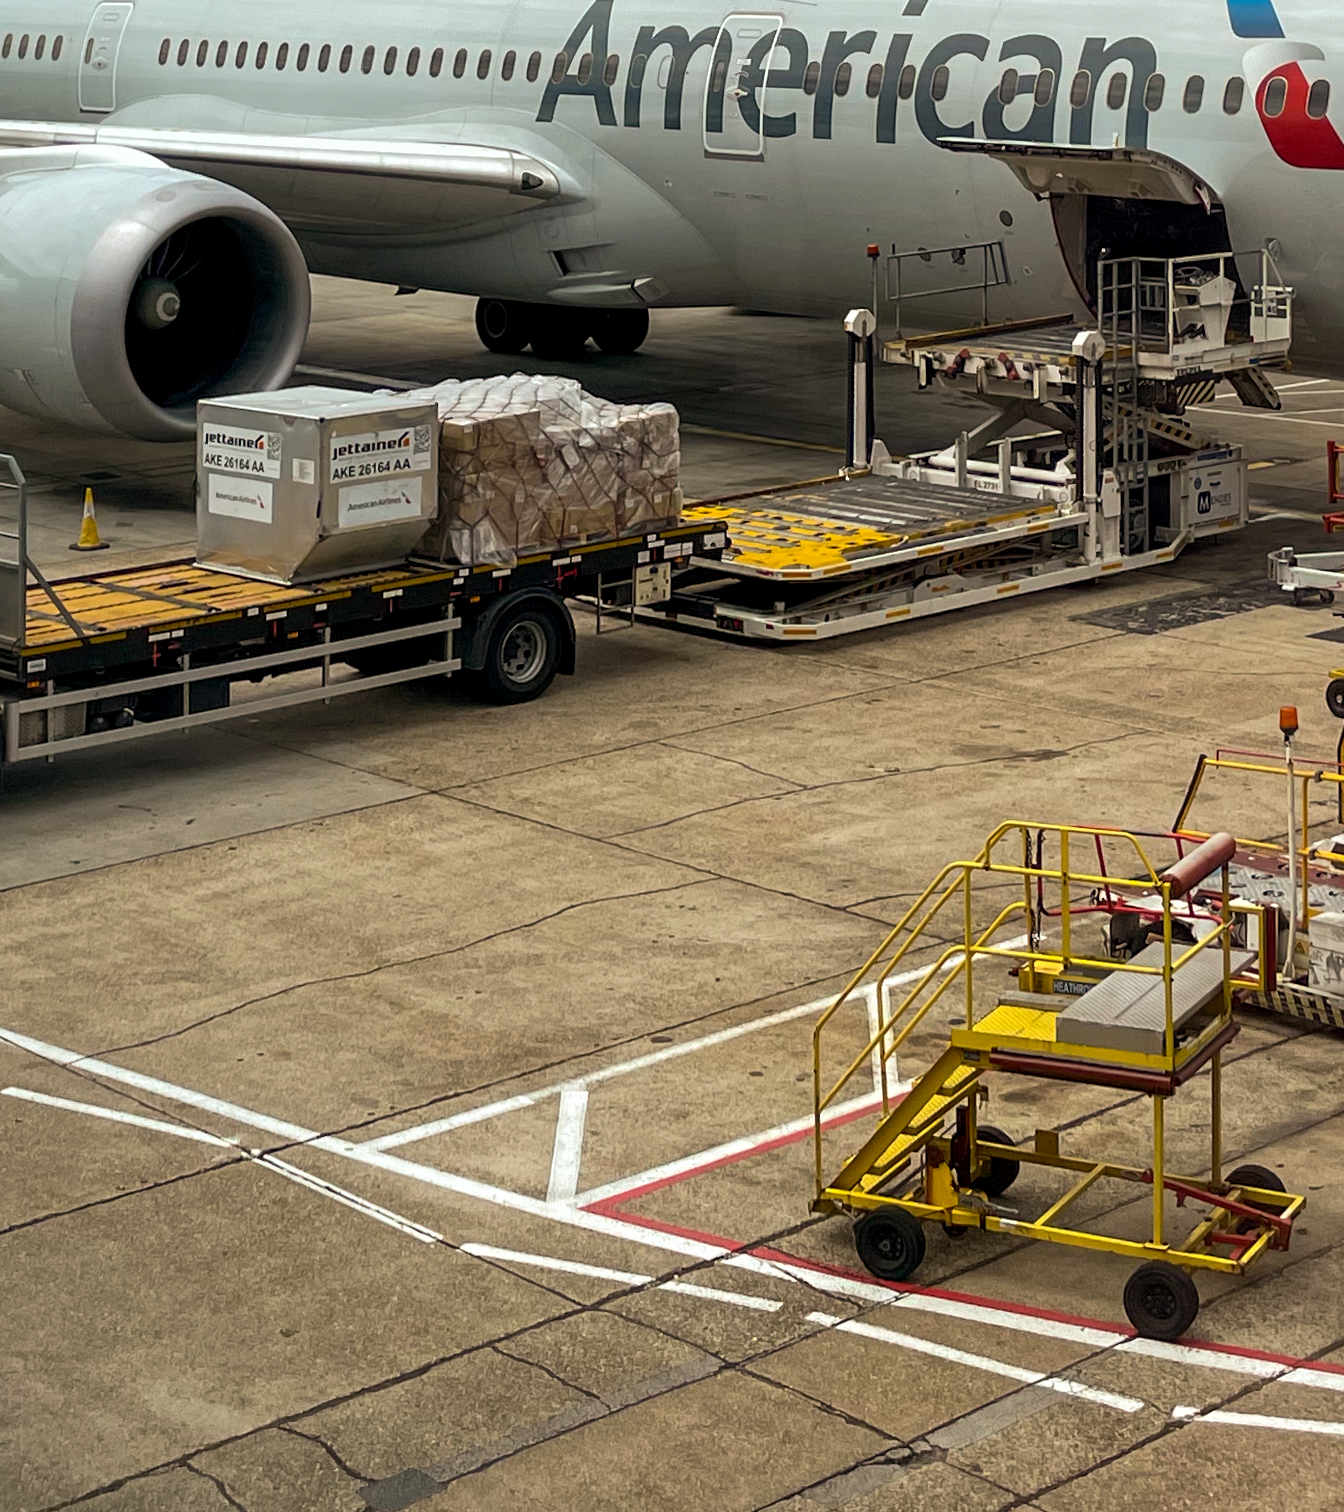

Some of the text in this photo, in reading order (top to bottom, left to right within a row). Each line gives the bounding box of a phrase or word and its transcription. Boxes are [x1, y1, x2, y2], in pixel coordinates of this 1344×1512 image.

[205, 453, 223, 467] AKE
[252, 461, 265, 472] AA
[332, 458, 411, 481] AKE 26164 AA
[1054, 980, 1093, 995] HEATHRO
